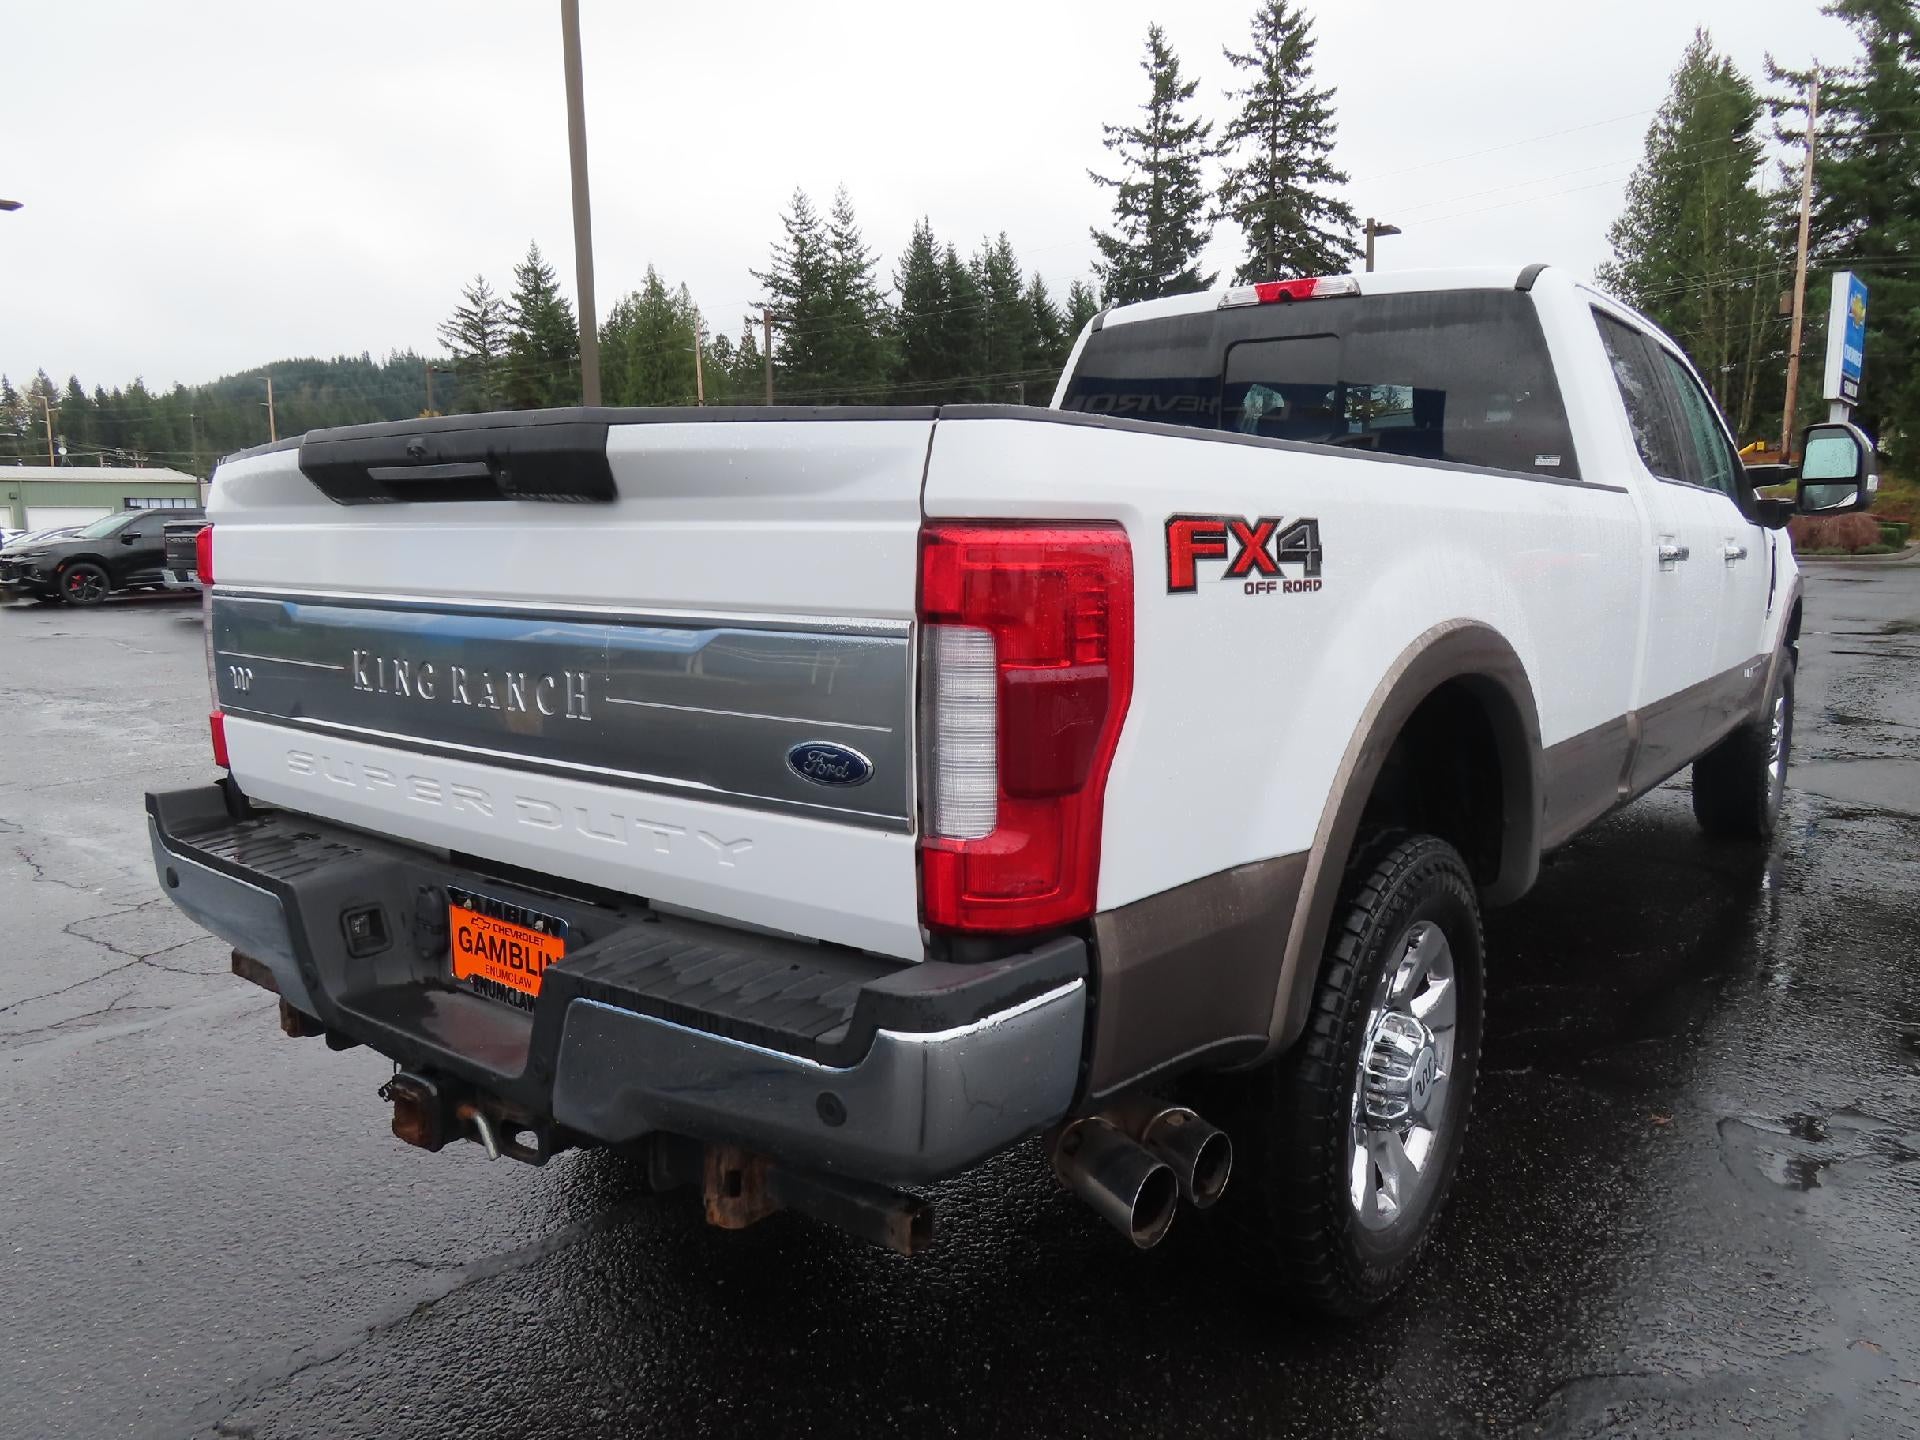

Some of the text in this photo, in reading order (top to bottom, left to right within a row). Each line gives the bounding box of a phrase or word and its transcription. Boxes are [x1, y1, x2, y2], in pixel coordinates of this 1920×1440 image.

[1165, 512, 1322, 595] FX4
[1244, 579, 1323, 595] OFF ROAD
[352, 648, 592, 720] KING RANCH
[803, 750, 849, 778] Ford
[286, 749, 753, 867] SUPER DUTY
[492, 923, 545, 948] CHEVROLET
[485, 964, 532, 989] ENUMCLAW
